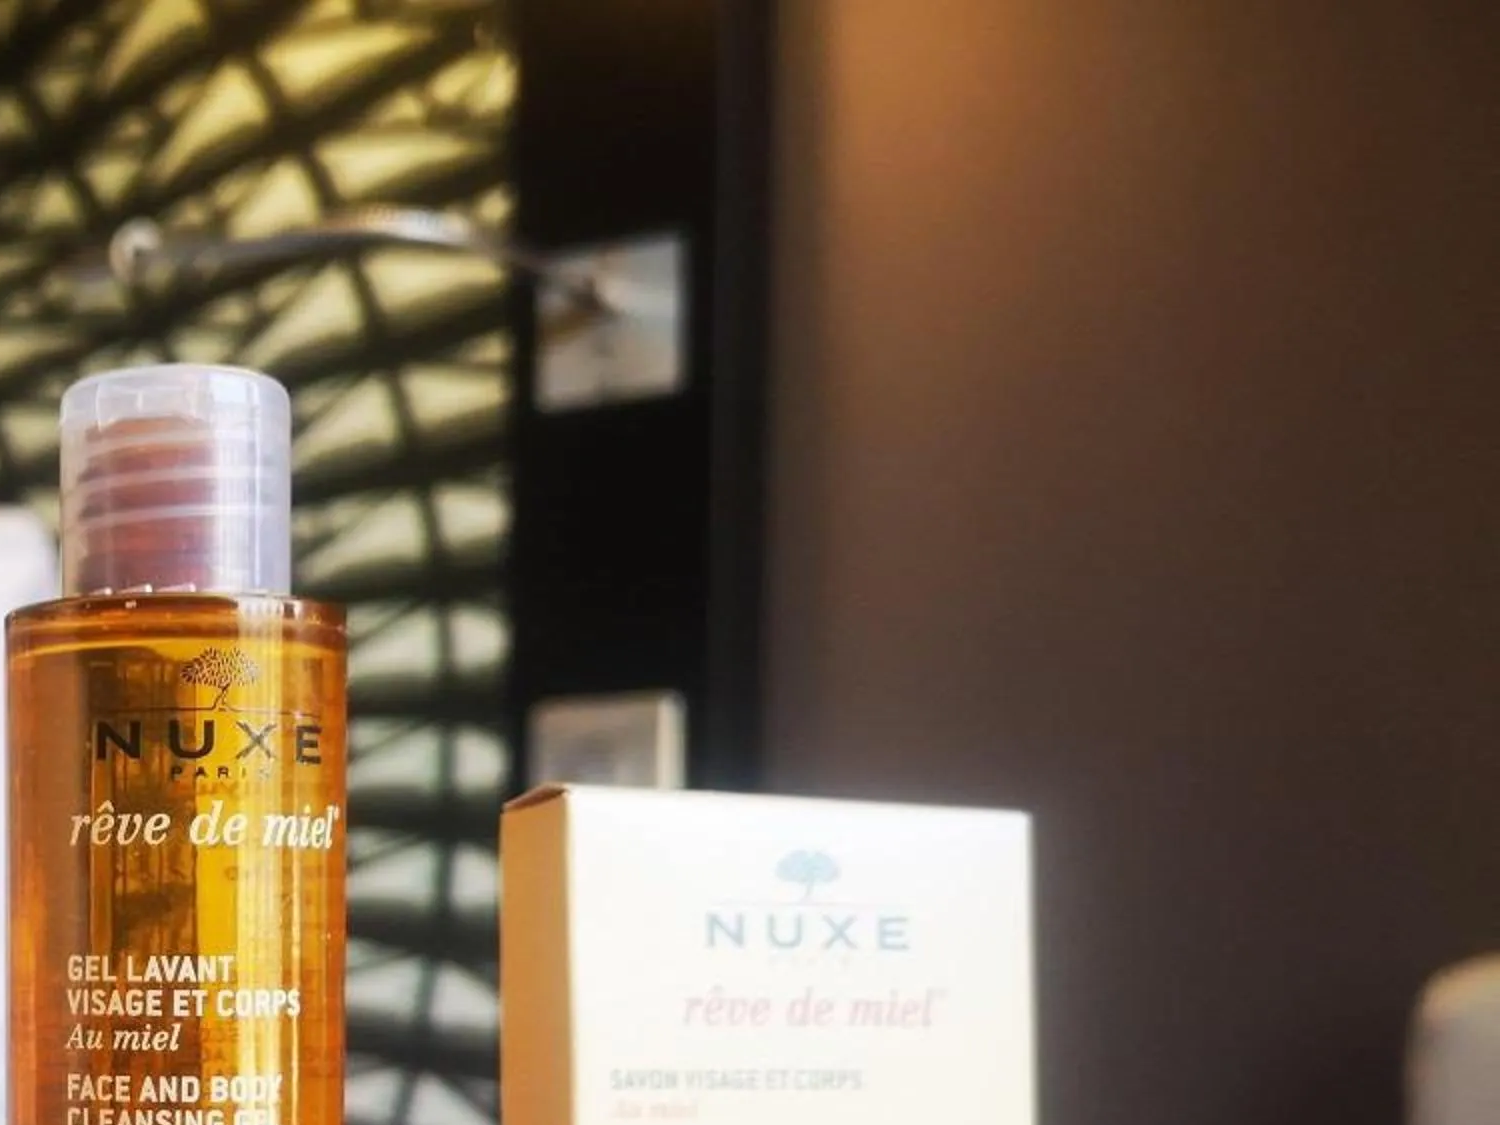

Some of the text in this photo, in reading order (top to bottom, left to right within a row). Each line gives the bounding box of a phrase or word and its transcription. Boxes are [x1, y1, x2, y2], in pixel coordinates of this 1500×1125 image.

[96, 719, 322, 765] NUXE
[171, 766, 271, 779] PARIS
[69, 800, 171, 846] rêve
[189, 800, 250, 846] de
[705, 913, 911, 950] NUXE
[67, 955, 235, 982] GEL LAVANT
[66, 989, 301, 1017] VISAGE ET CORPS
[683, 985, 771, 1027] rêve
[786, 987, 834, 1027] de
[65, 1023, 181, 1051] Au miel
[67, 1073, 282, 1103] FACE AND BODY
[610, 1069, 864, 1090] SAVON VISAGE ET CORPS
